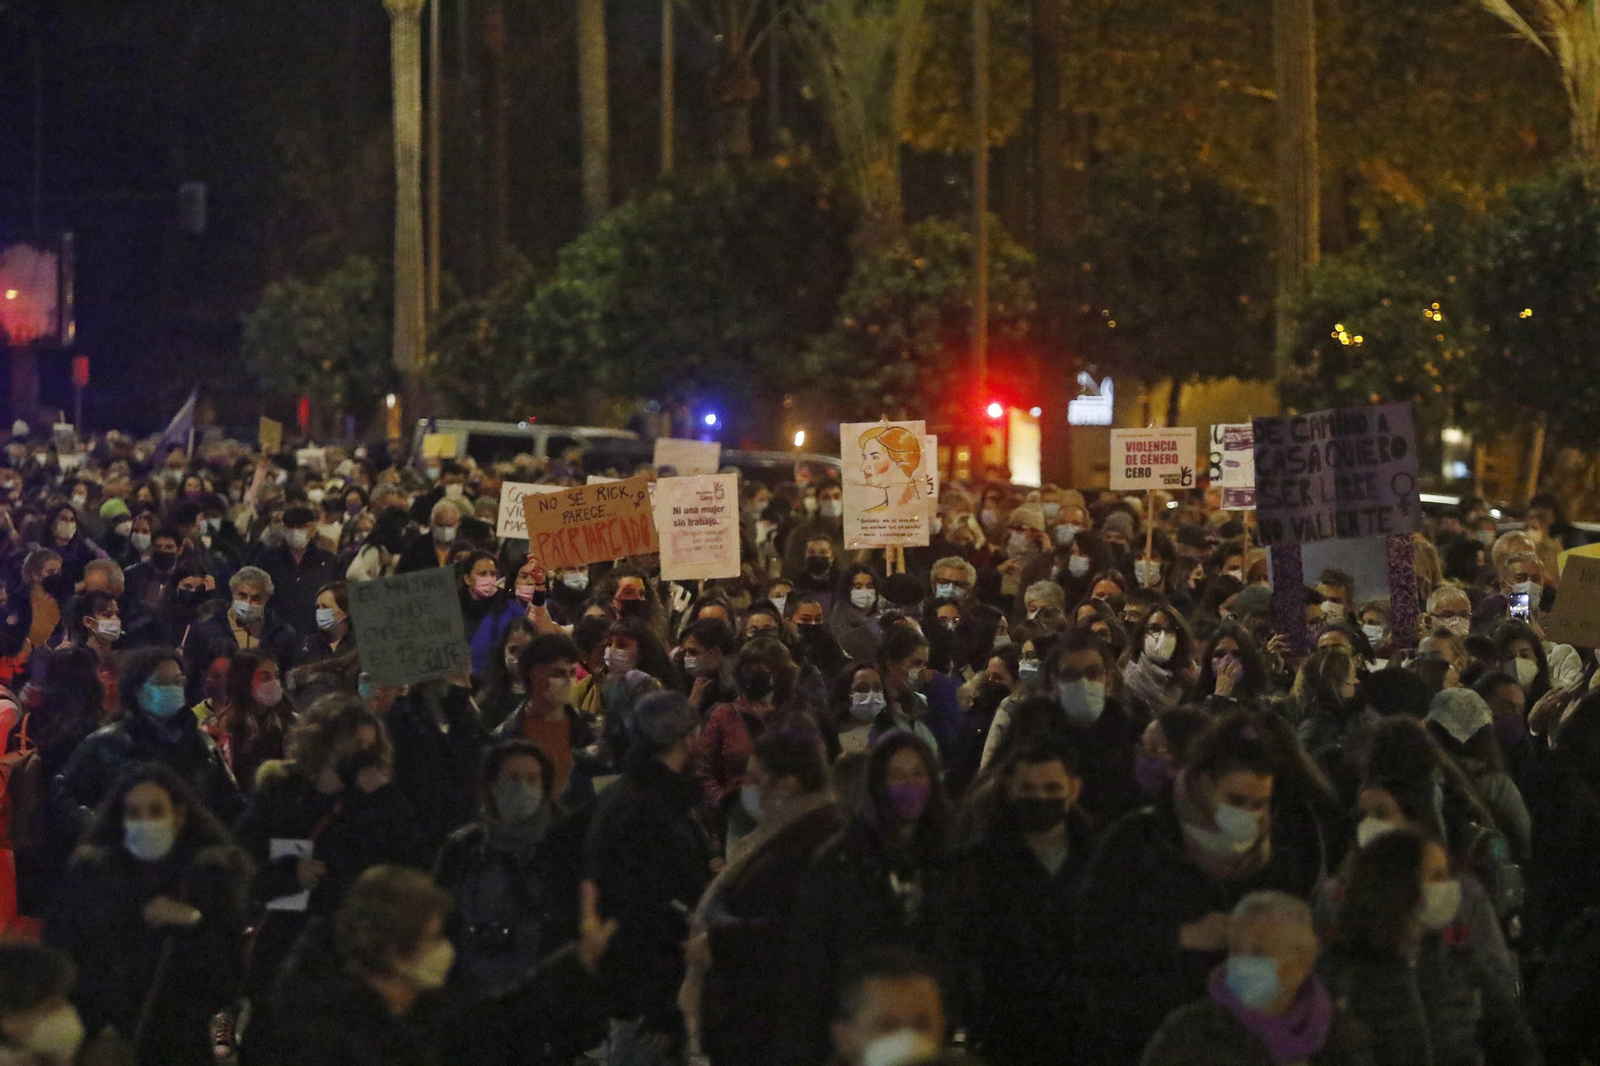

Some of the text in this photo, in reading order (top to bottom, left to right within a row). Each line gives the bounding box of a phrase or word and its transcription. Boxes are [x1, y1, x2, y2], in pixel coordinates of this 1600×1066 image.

[1290, 413, 1368, 442] CAMINO
[1377, 413, 1390, 434] A
[1125, 440, 1178, 452] VIOLENCIA
[1256, 443, 1322, 475] CASA
[1326, 435, 1407, 468] QUIERO
[1125, 454, 1138, 466] DE
[1125, 467, 1151, 479] CERO
[538, 498, 558, 512] NO
[567, 489, 585, 507] SÉ
[596, 486, 634, 502] RICK,
[1259, 478, 1314, 509] SER
[672, 506, 682, 515] Ni
[700, 505, 725, 515] mujer
[673, 517, 719, 527] sin trabajo.
[1259, 506, 1394, 545] NO VALIENTE
